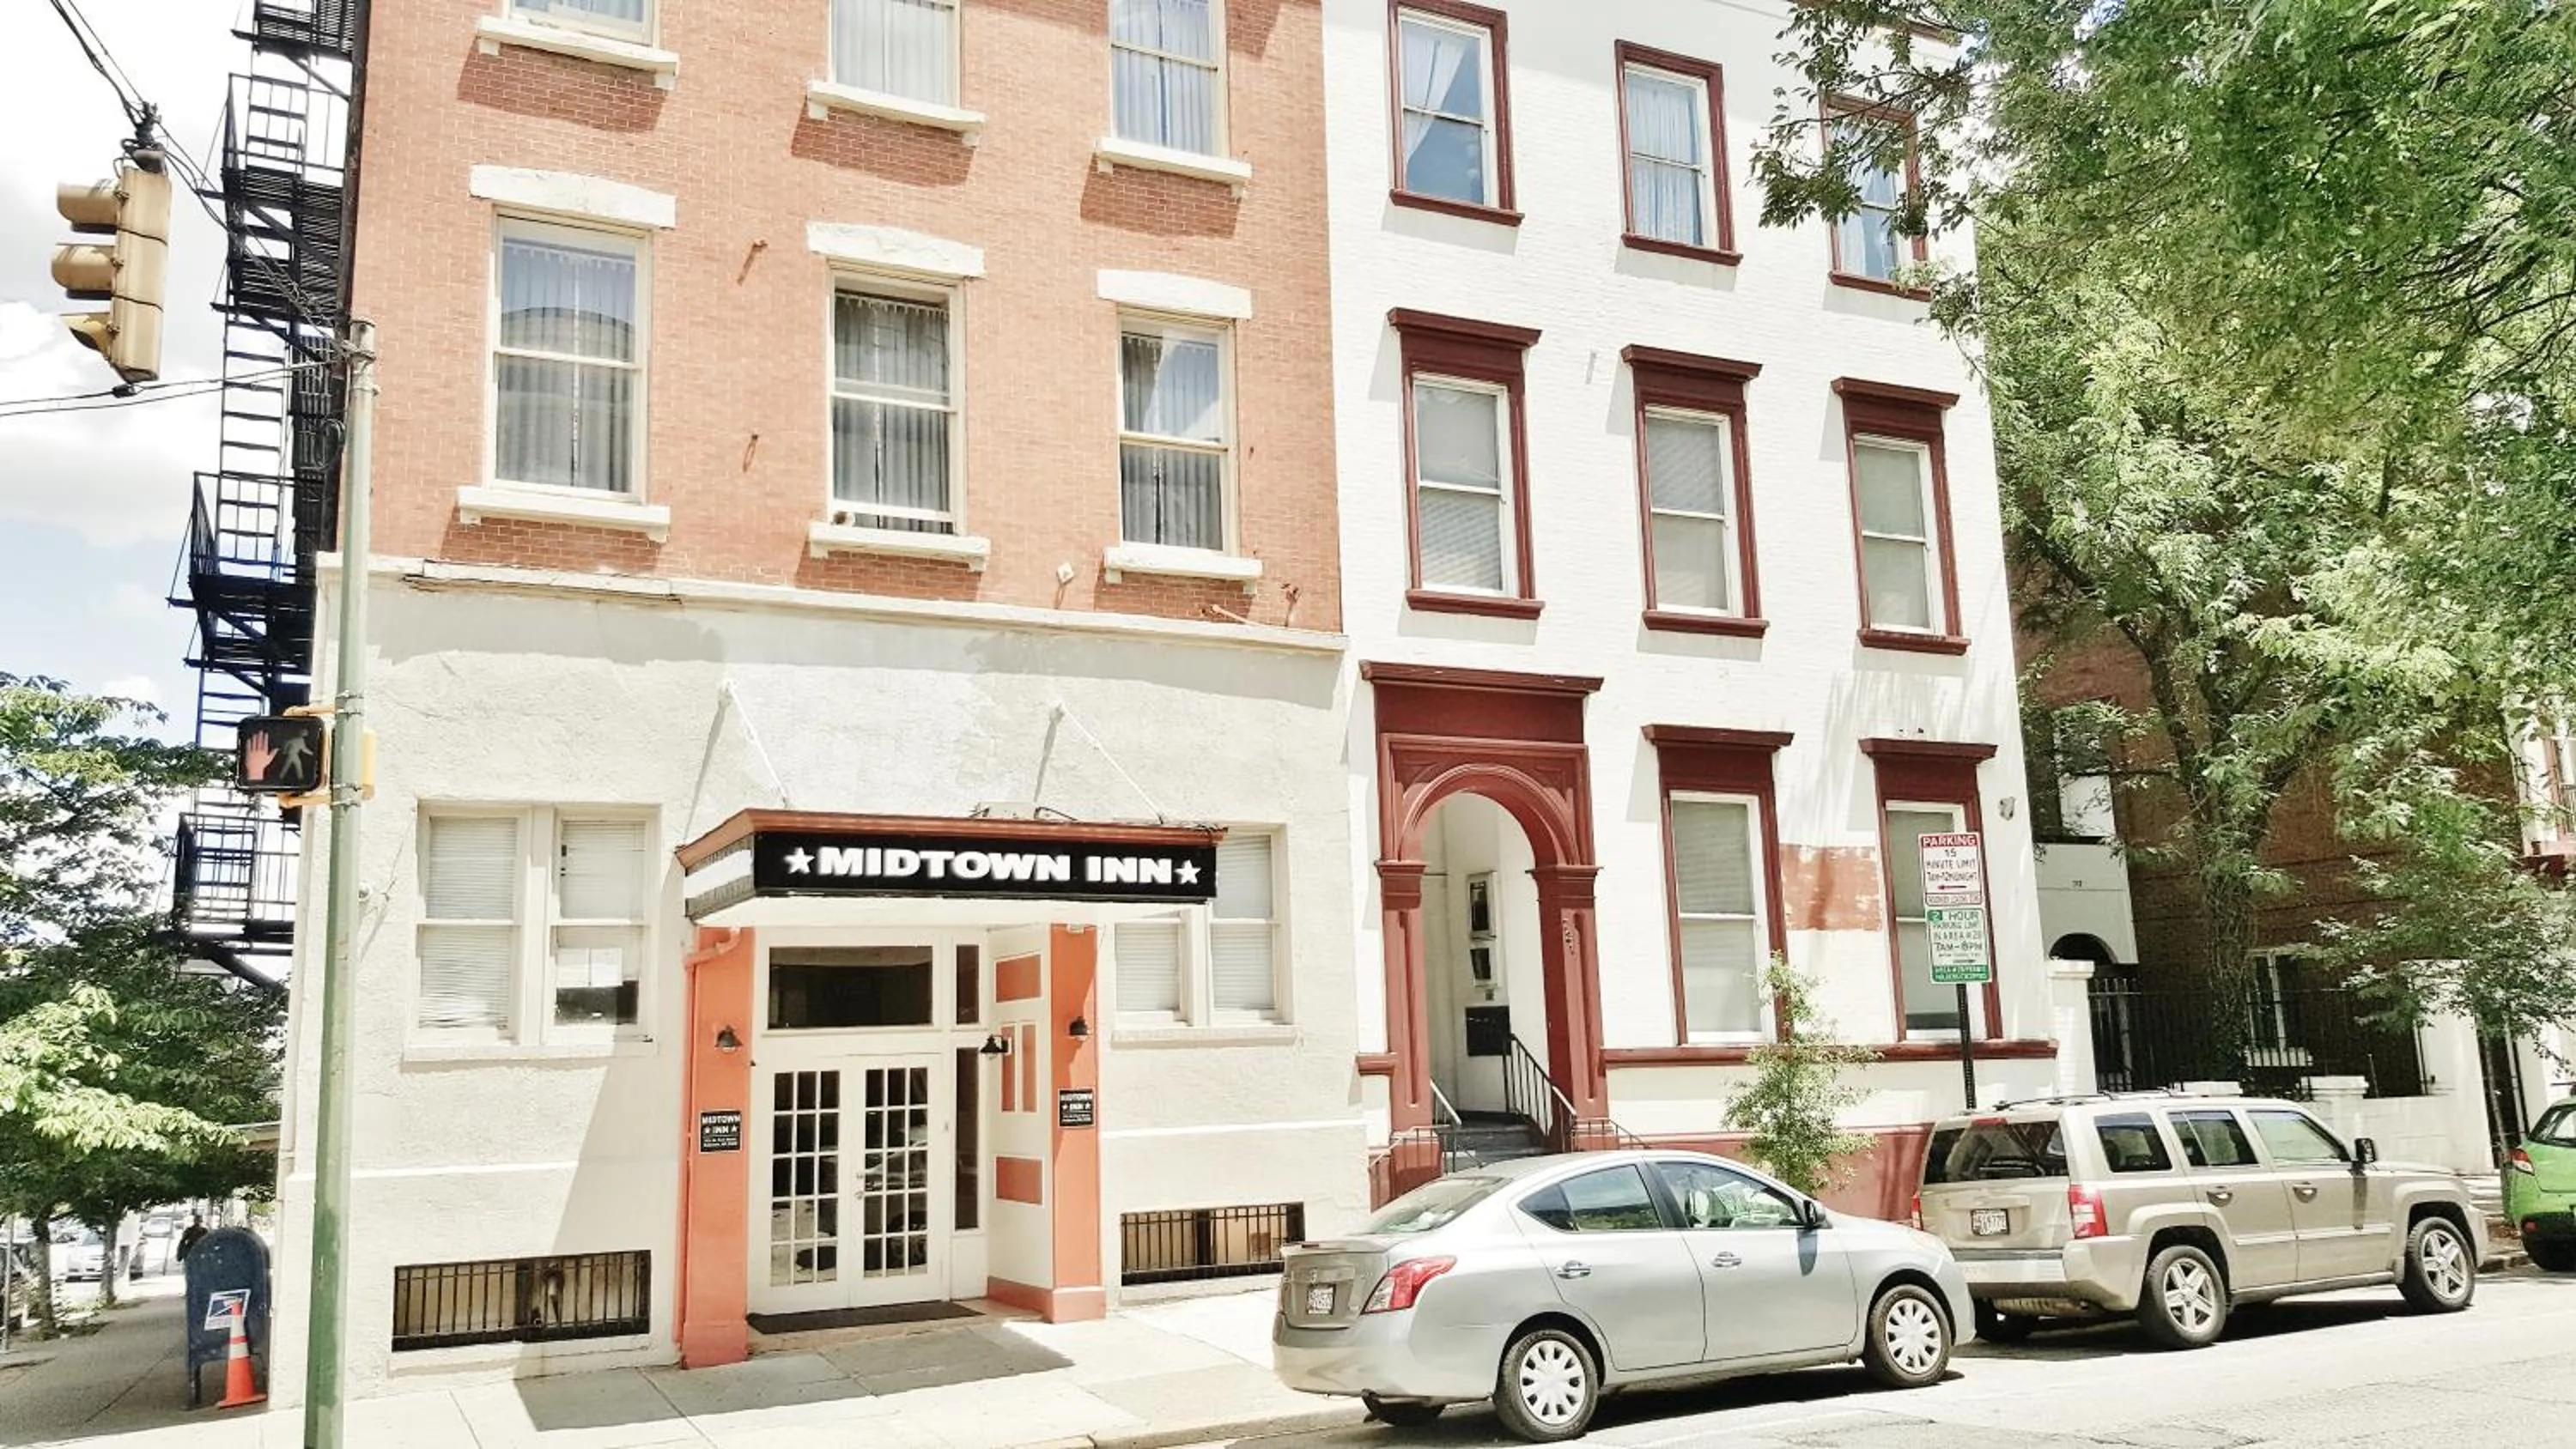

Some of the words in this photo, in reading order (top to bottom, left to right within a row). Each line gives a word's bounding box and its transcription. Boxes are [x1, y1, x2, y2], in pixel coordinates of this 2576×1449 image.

[1923, 835, 1976, 847] PARKING
[1944, 848, 1957, 858] 15
[818, 846, 1071, 881] MIDTOWN
[1086, 856, 1172, 884] INN
[1926, 859, 1954, 869] MINUTE
[1956, 858, 1976, 869] LIMIT
[1948, 911, 1978, 921] HOUR
[702, 1115, 740, 1125] MIDTOWN
[713, 1125, 729, 1134] INN
